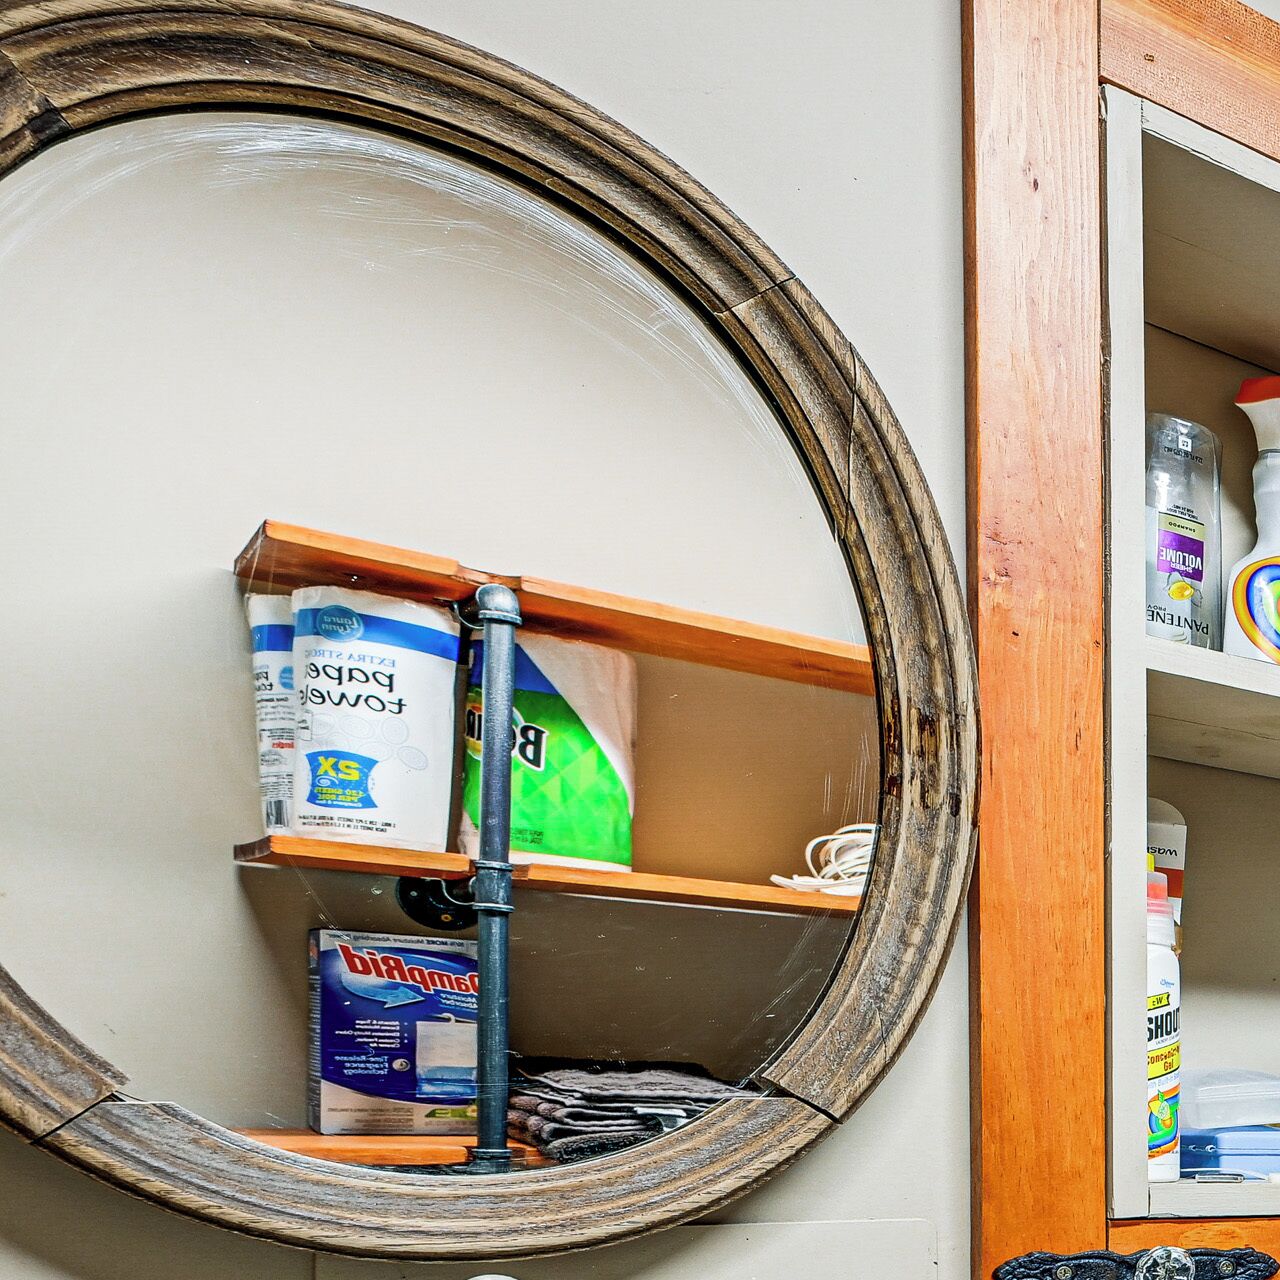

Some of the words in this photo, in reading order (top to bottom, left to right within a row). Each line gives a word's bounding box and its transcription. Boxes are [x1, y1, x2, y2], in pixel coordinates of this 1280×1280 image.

[1168, 521, 1196, 533] SHAMPOO
[1159, 546, 1203, 571] VOLUME
[1170, 562, 1193, 574] SHEER
[1147, 609, 1209, 636] PANTENE
